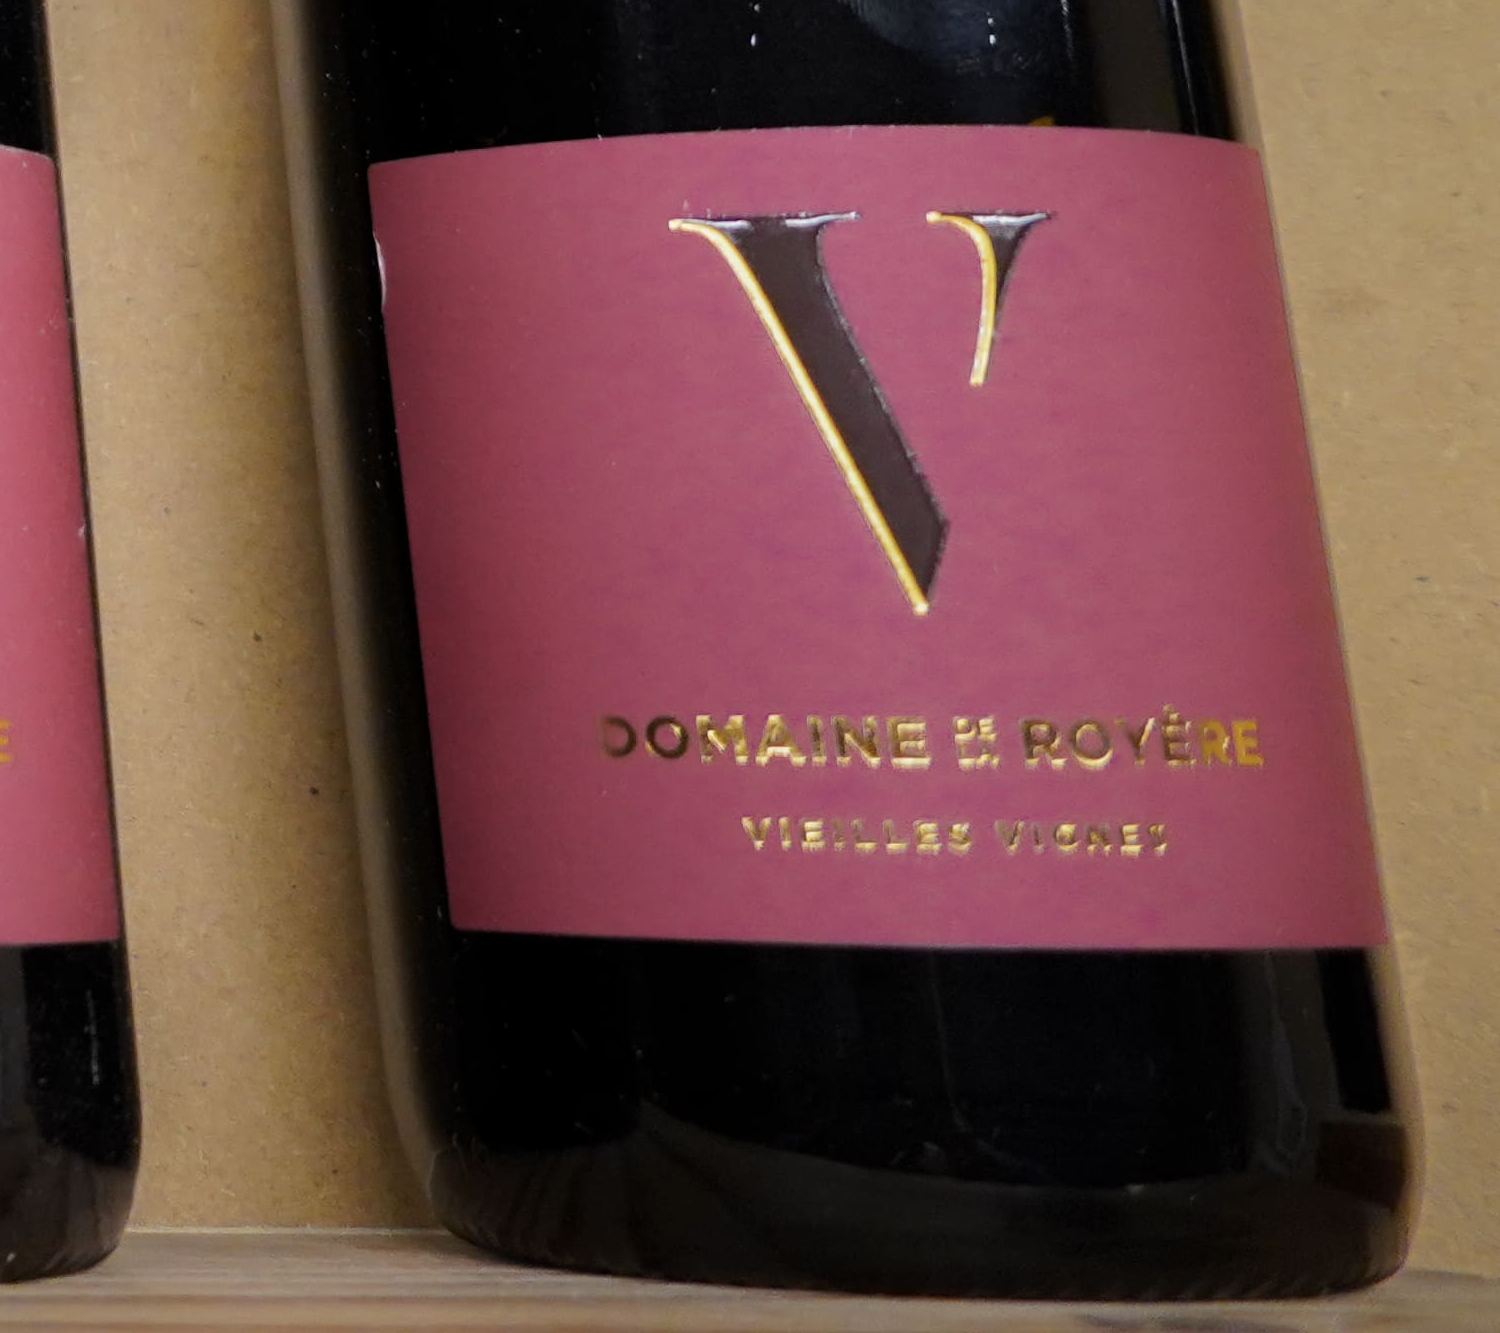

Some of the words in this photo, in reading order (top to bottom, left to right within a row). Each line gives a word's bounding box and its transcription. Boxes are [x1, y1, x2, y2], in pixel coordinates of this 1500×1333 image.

[665, 210, 1051, 614] V
[601, 713, 932, 769] DOMAINE
[1018, 704, 1264, 769] ROYÈRE
[741, 817, 972, 854] VIEILLES
